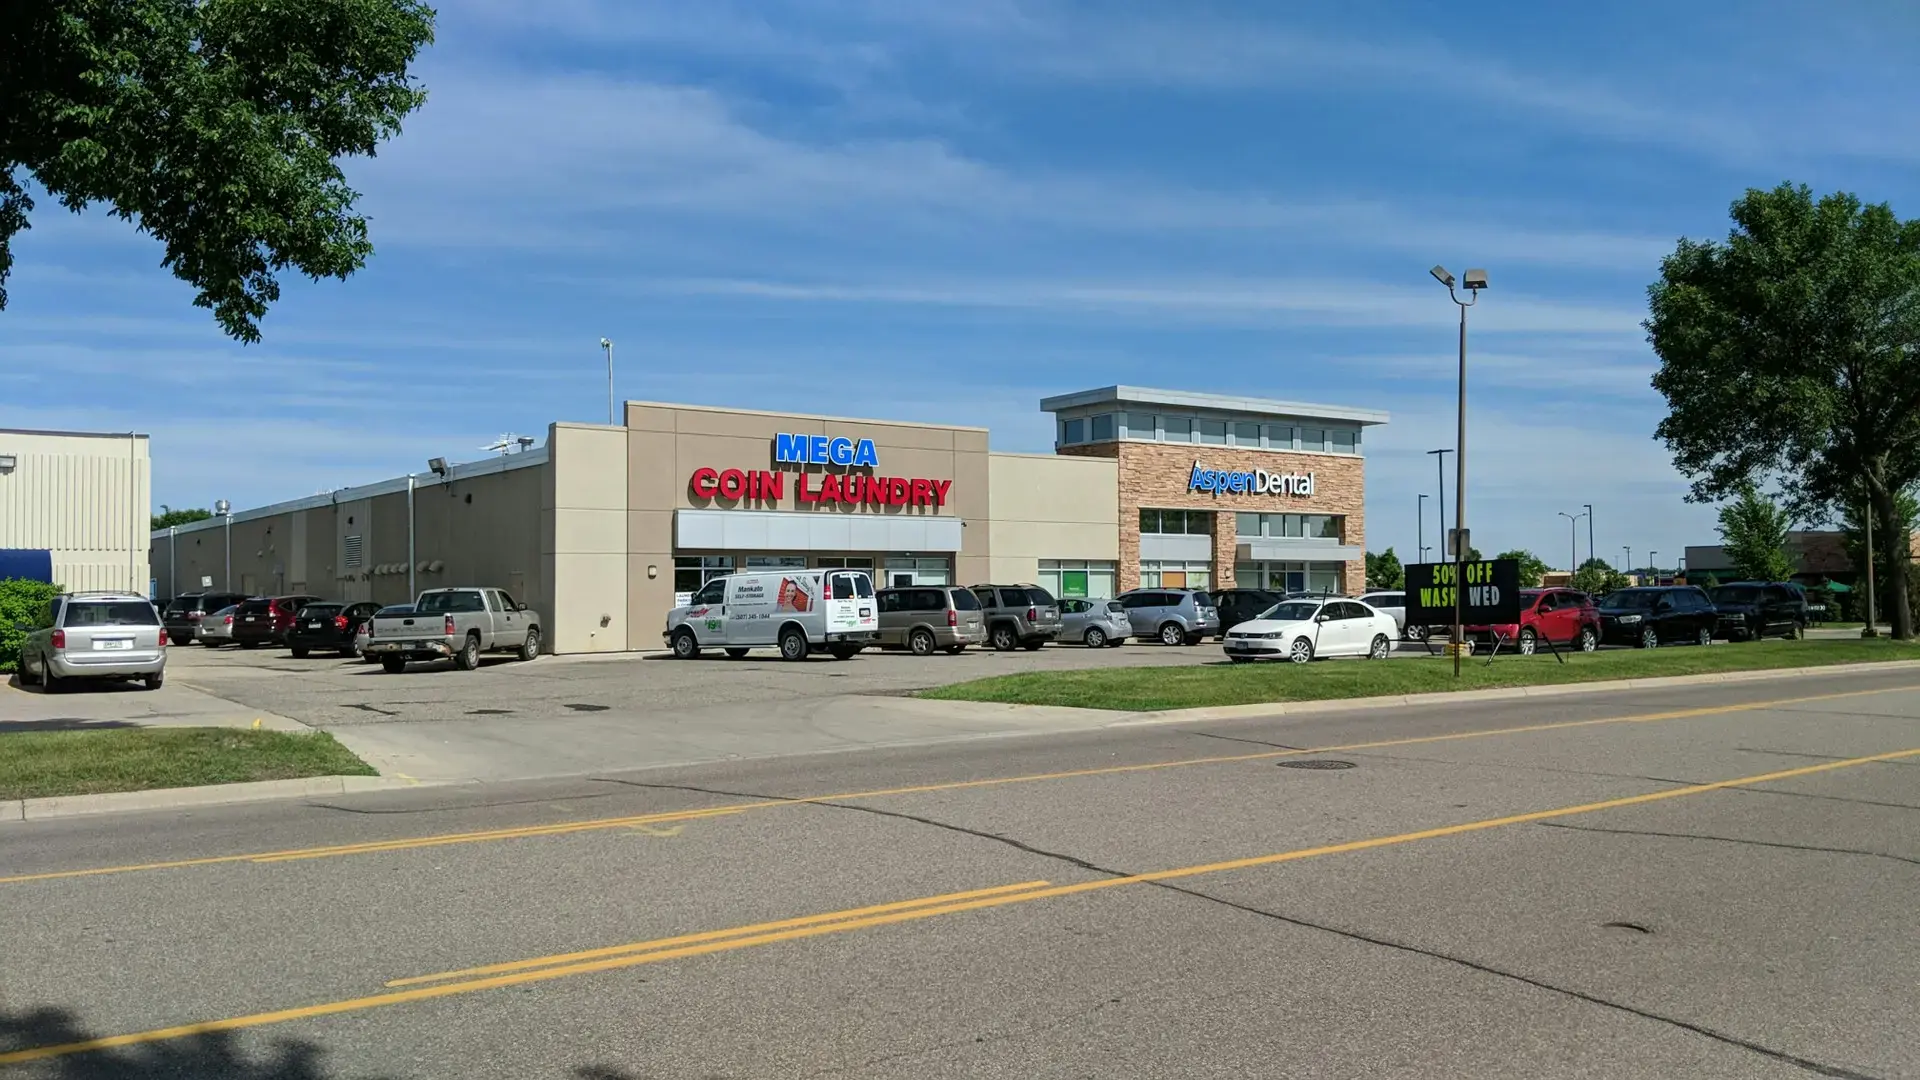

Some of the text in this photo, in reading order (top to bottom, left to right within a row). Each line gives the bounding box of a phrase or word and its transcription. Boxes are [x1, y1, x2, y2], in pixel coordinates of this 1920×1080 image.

[776, 433, 879, 467] MEGA
[693, 467, 952, 506] COIN LAUNDRY
[1466, 563, 1493, 584] OFF
[738, 585, 763, 593] Mankato
[1420, 586, 1500, 608] WASH WED
